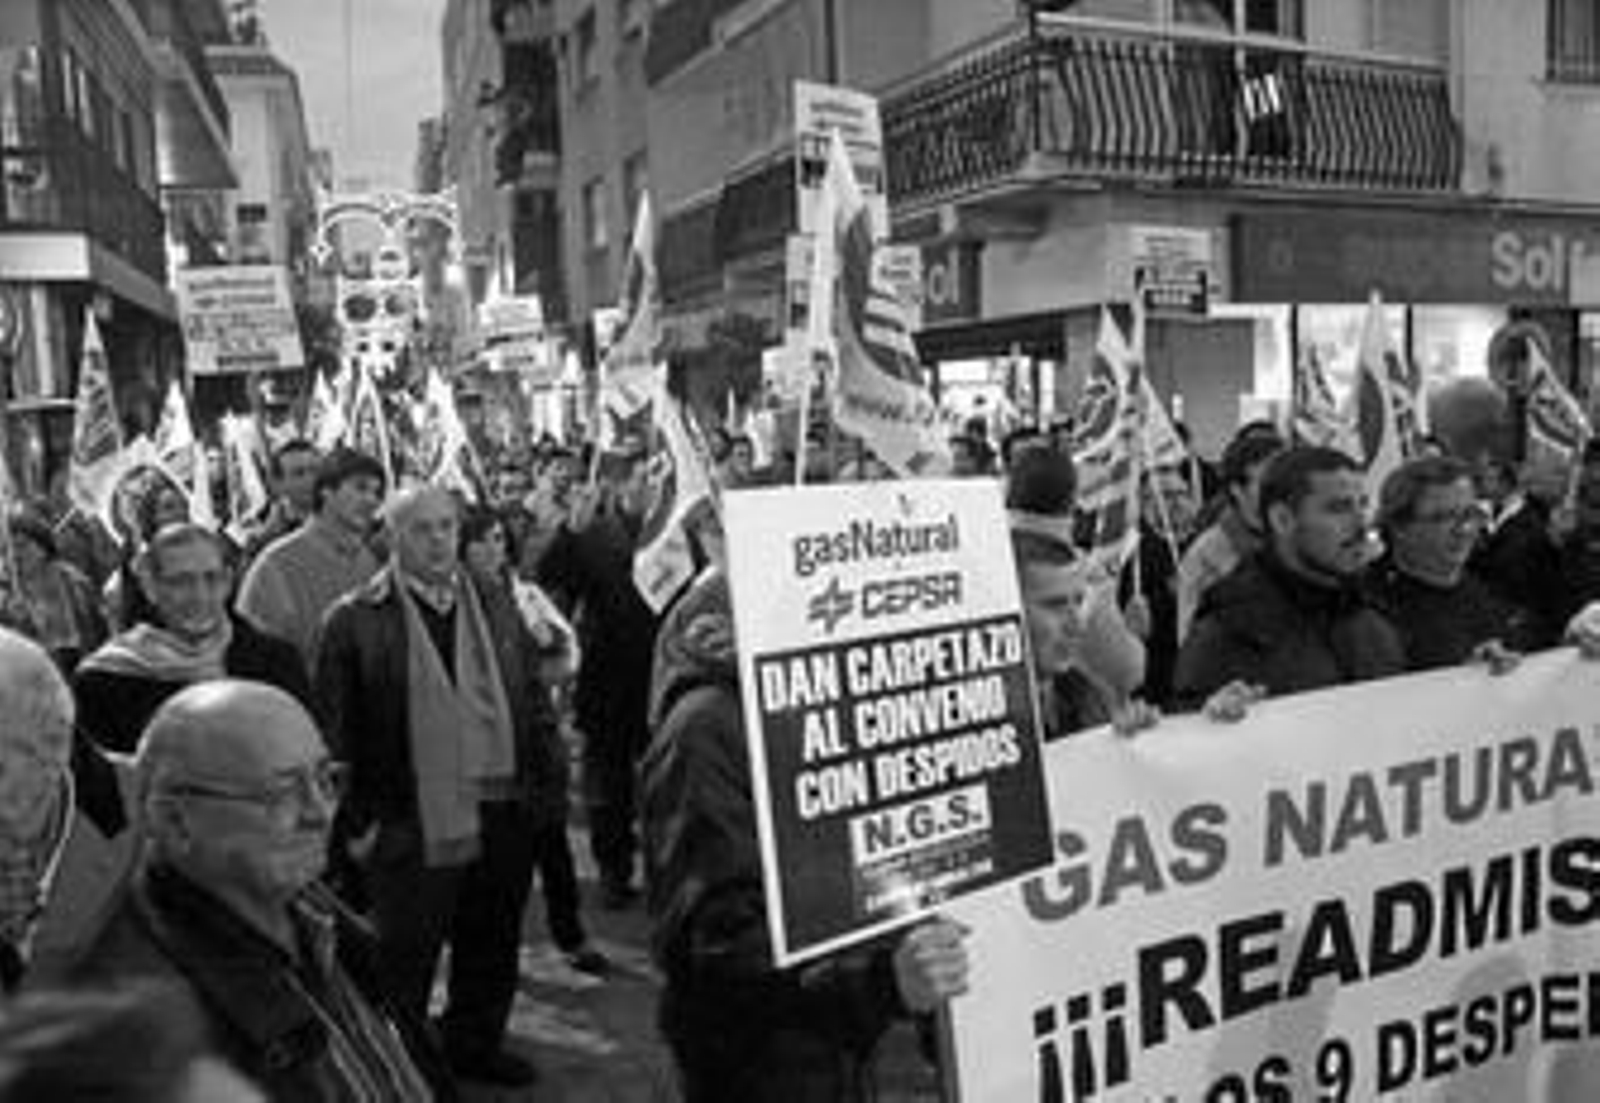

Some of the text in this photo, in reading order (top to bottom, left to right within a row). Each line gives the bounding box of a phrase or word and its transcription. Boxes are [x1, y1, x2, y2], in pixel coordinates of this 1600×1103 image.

[1492, 231, 1564, 291] Sol
[794, 513, 958, 576] gasNatural
[861, 571, 961, 619] CEPSA
[761, 622, 1021, 712] DAN CARPETAZO
[804, 675, 1007, 763] AL CONVENIO
[797, 723, 1021, 819] CON DESPIDOS
[862, 794, 984, 854] N.G.S.
[1020, 803, 1228, 921] GAS
[1316, 1038, 1352, 1103] 9
[1377, 972, 1600, 1094] DESPE
